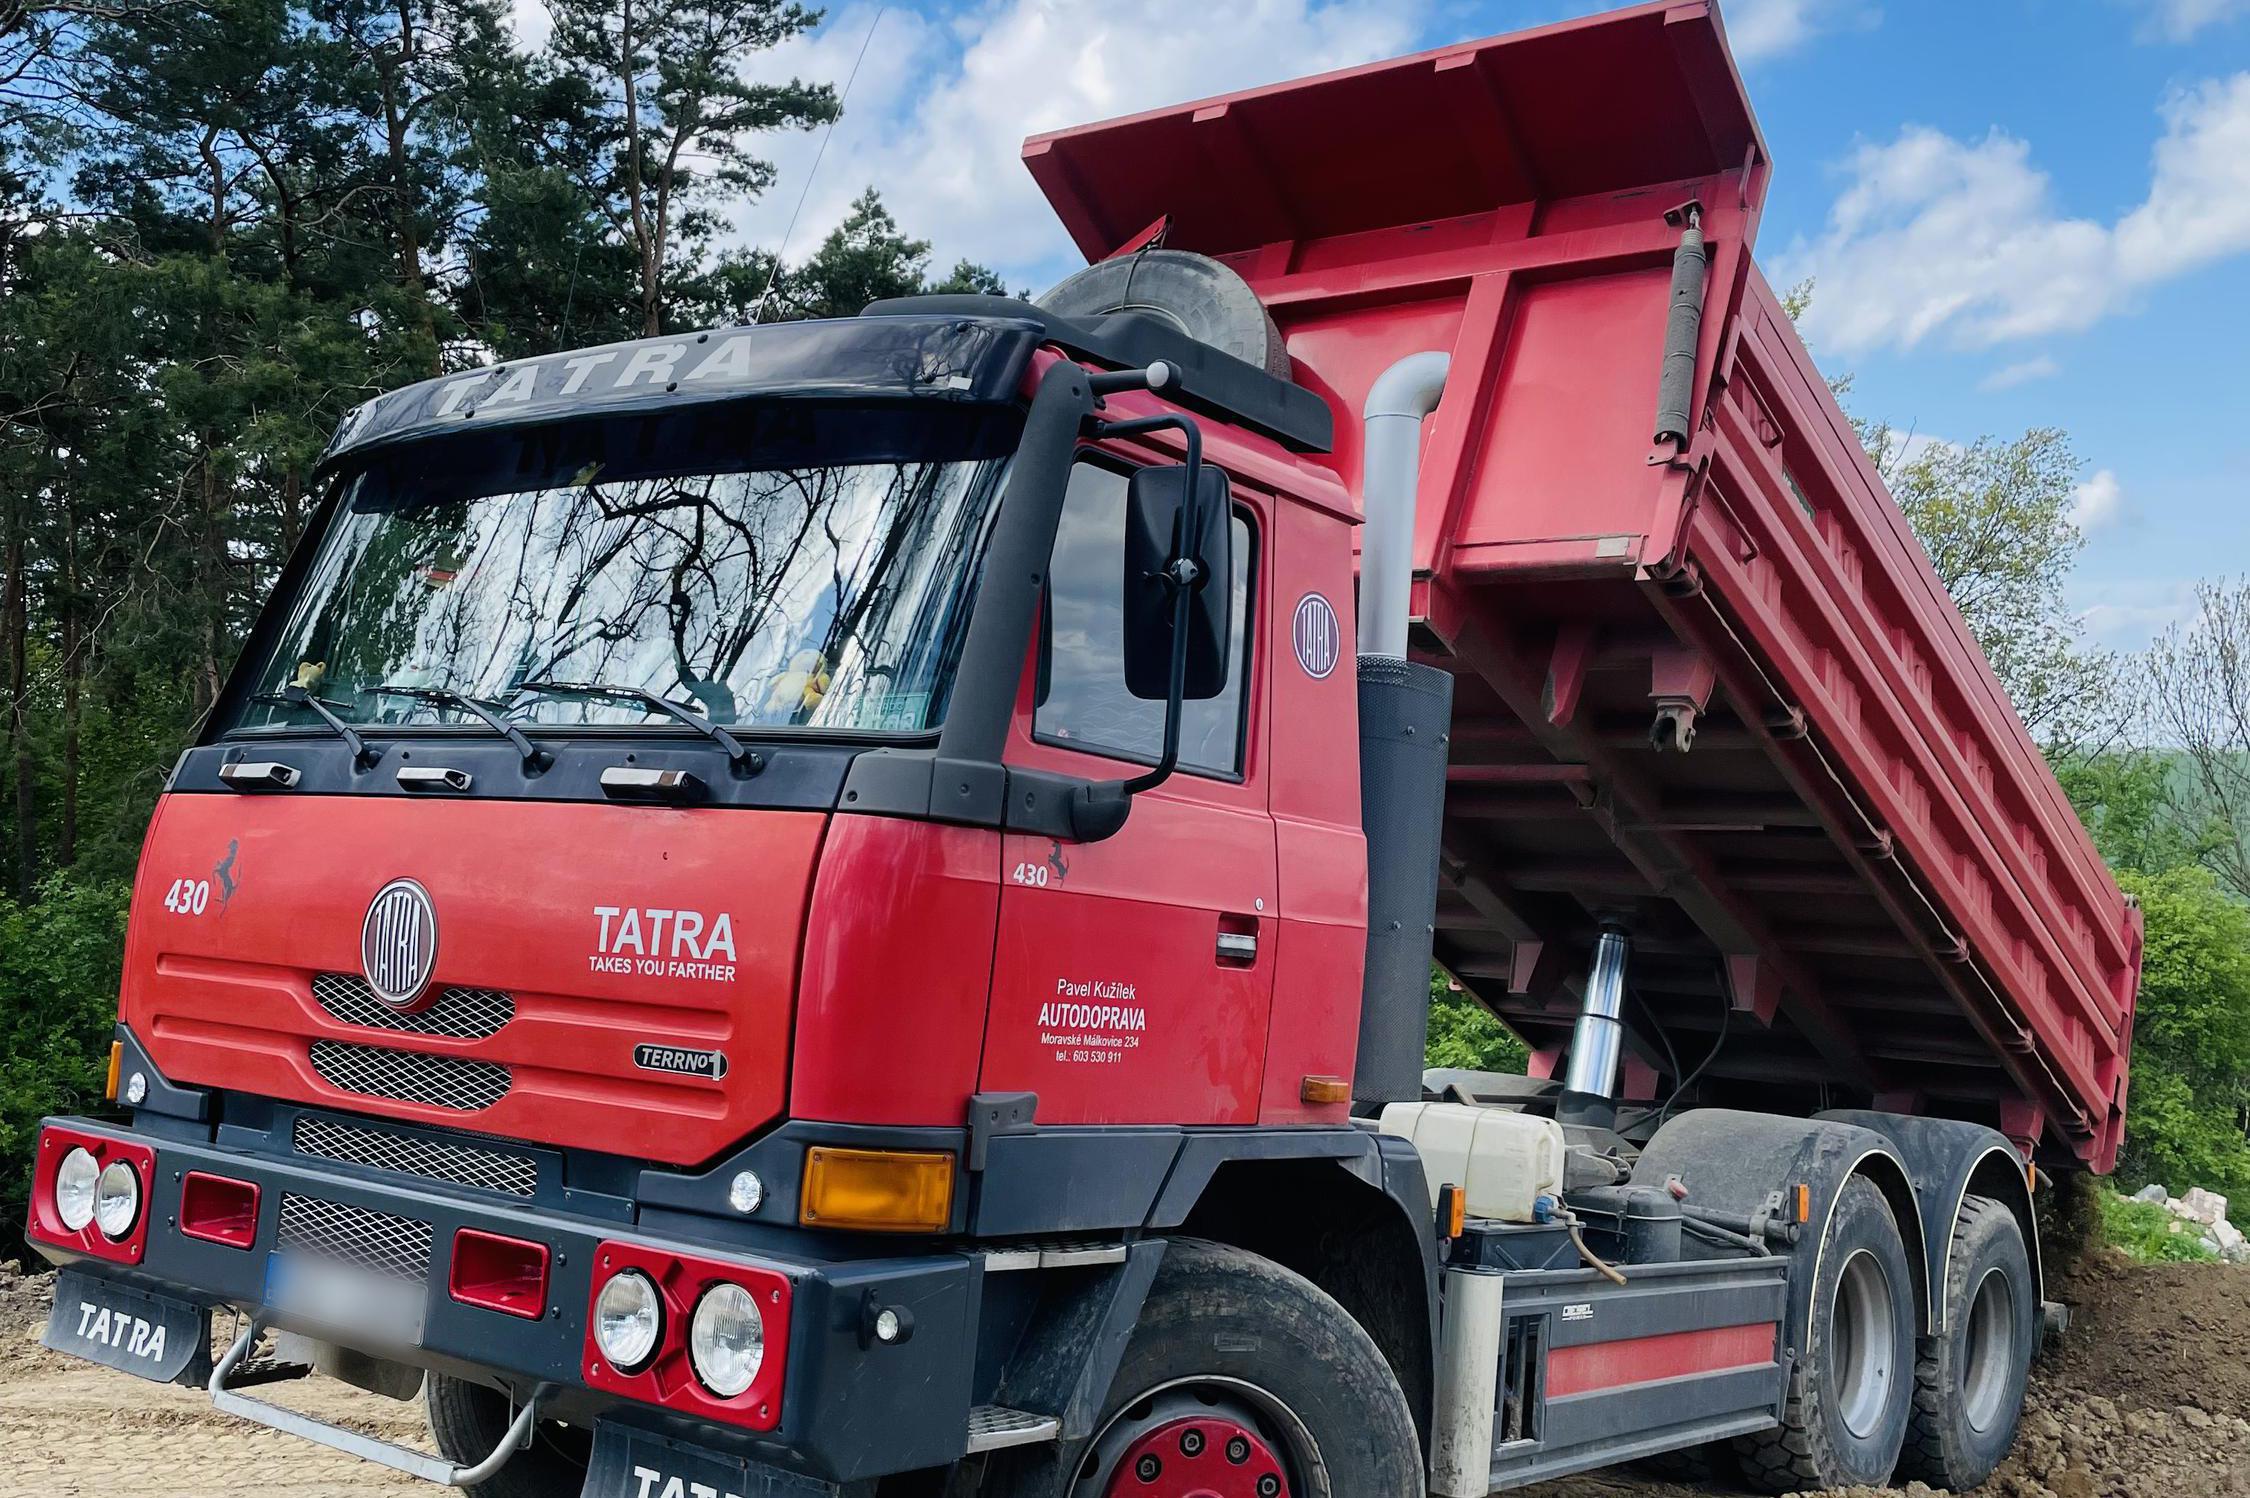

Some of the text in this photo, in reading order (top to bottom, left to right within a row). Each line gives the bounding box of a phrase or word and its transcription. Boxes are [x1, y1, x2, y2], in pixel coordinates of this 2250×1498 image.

[436, 335, 752, 417] TATRA
[1301, 601, 1330, 672] TATRA
[1013, 862, 1049, 887] 430
[164, 878, 210, 916] 430
[373, 891, 422, 993] TATRA
[593, 906, 737, 962] TATRA
[589, 956, 736, 982] TAKES YOU FARTHER
[1057, 978, 1136, 1000] Pavel Kužílek
[1038, 1002, 1146, 1031] AUTODOPRAVA
[1041, 1032, 1082, 1046] Moravské
[1124, 1036, 1139, 1048] 234
[1073, 1050, 1089, 1062] 603
[1090, 1051, 1106, 1063] 530
[1107, 1051, 1122, 1063] 911
[77, 1301, 166, 1362] TATRA
